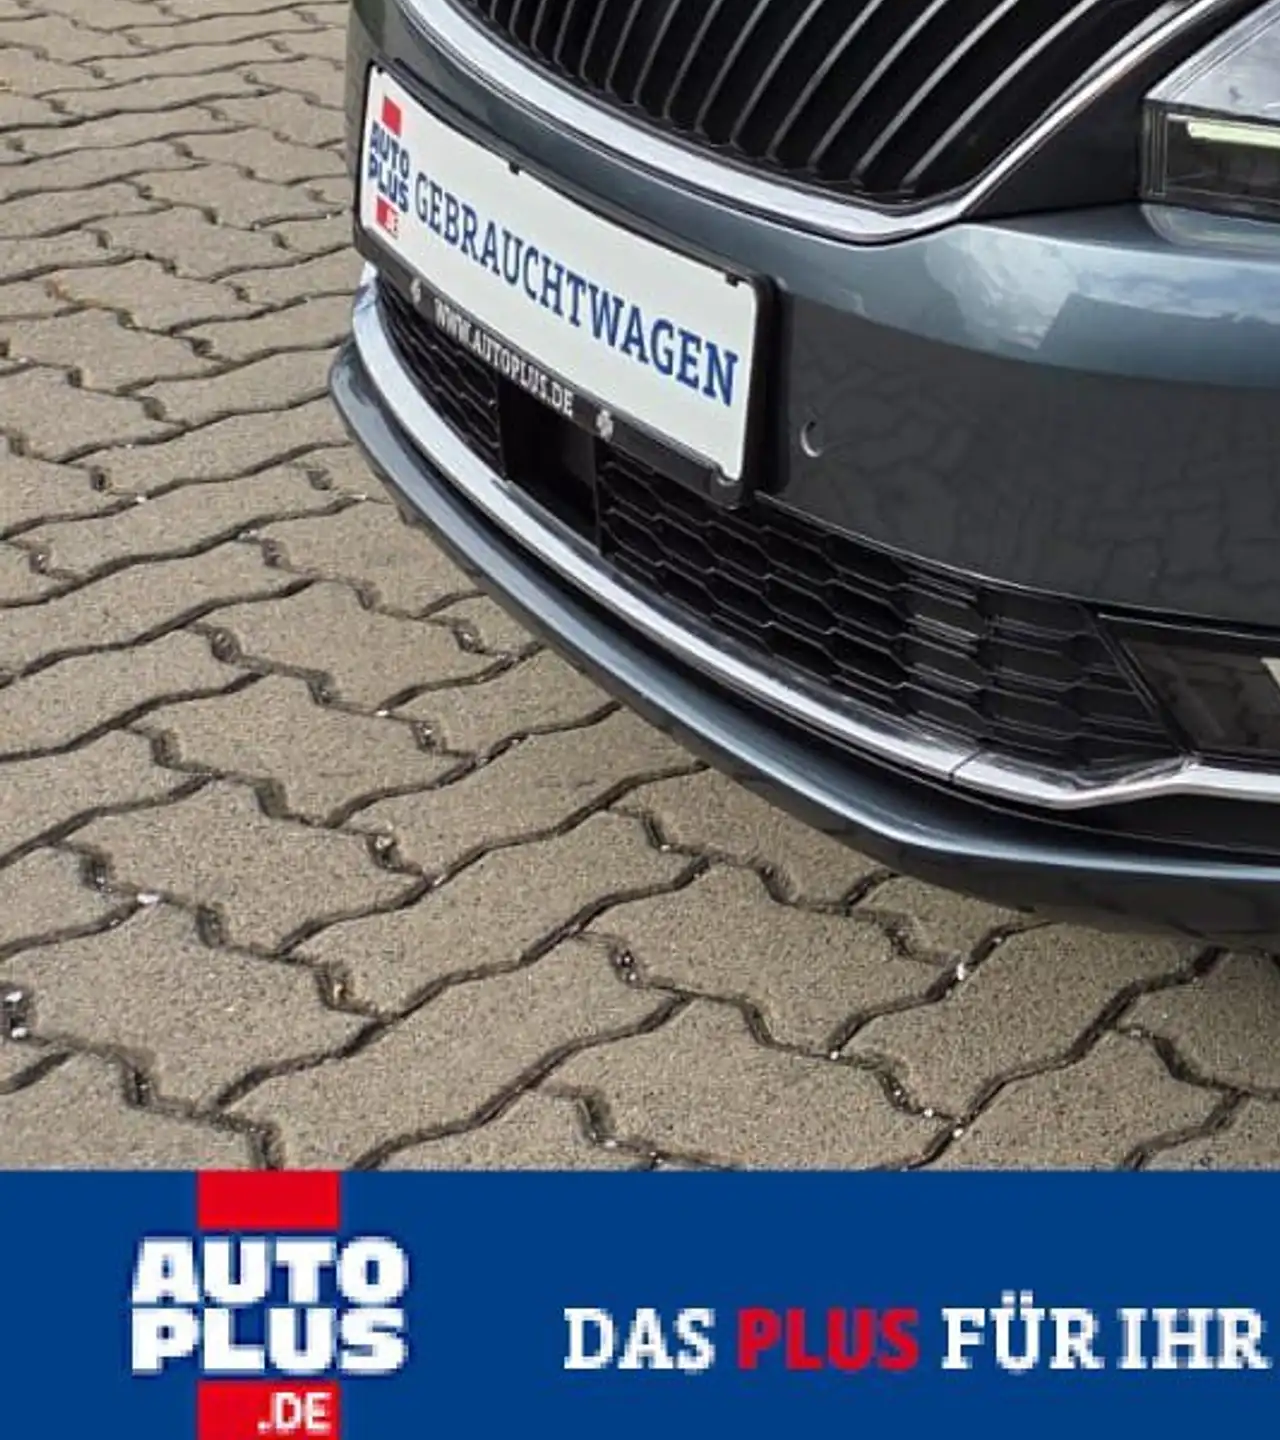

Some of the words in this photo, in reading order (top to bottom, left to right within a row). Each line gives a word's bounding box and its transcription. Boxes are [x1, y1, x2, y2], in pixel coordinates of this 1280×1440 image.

[368, 153, 410, 213] PLUS
[370, 120, 410, 180] AUTO
[415, 172, 739, 407] GEBRAUCHTWAGEN
[434, 297, 575, 417] WWW.AUTOPLUS.DE
